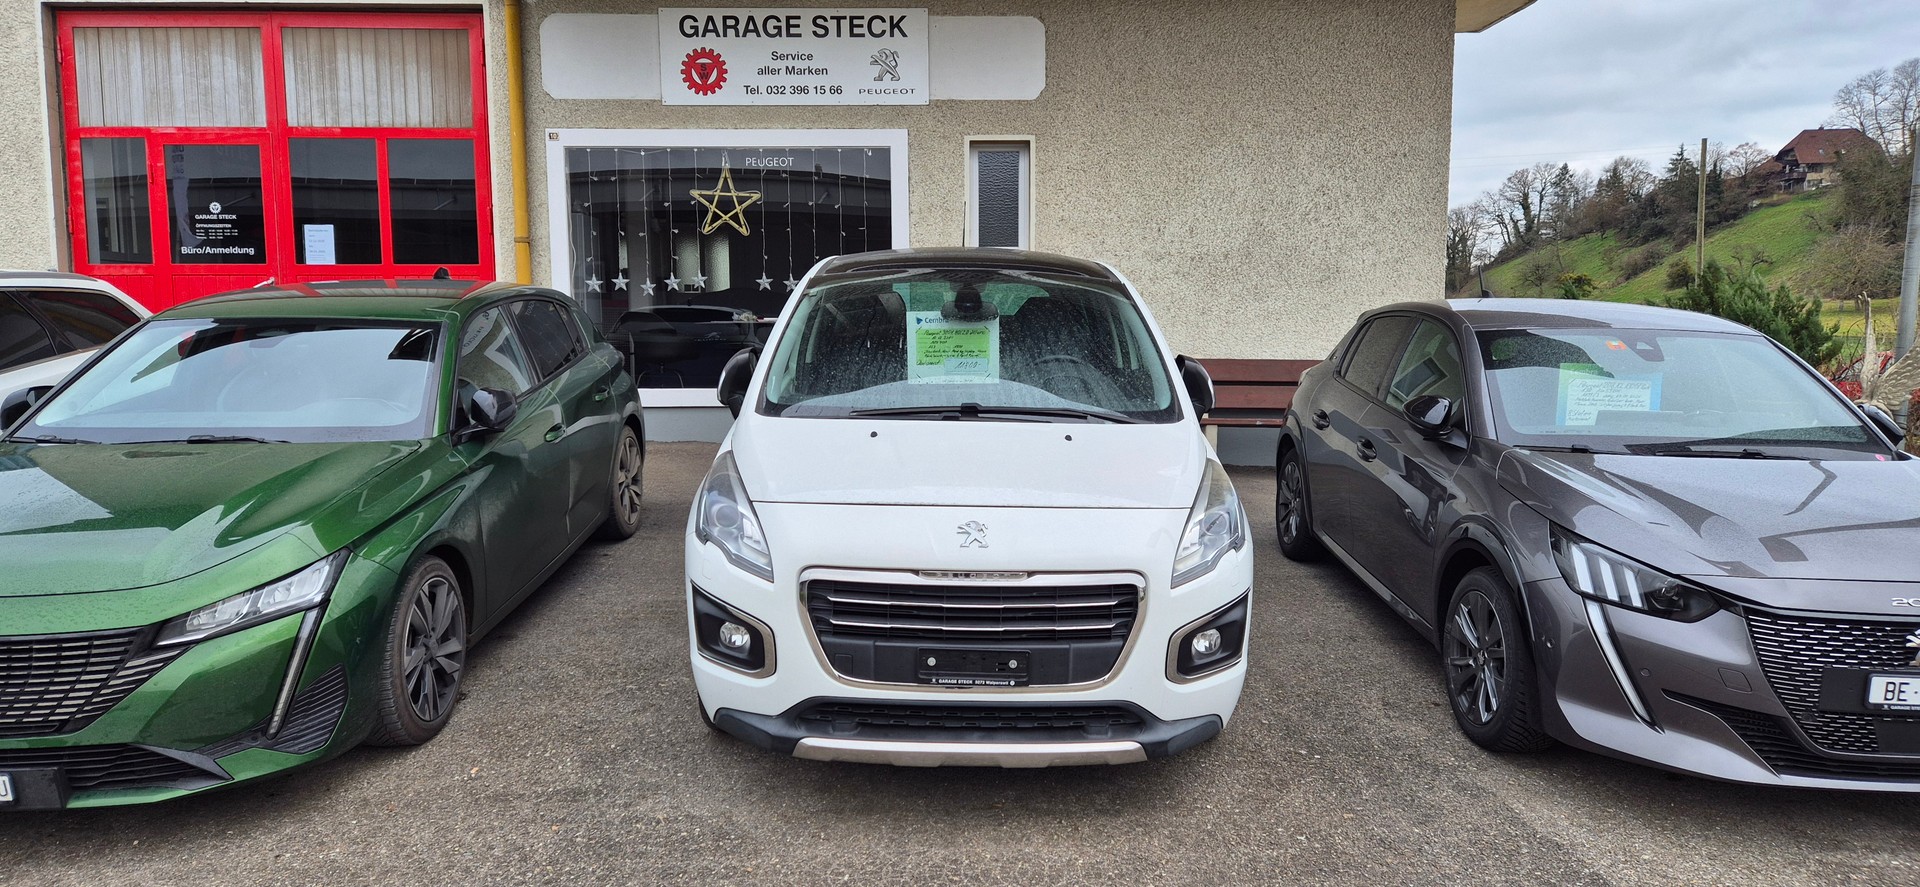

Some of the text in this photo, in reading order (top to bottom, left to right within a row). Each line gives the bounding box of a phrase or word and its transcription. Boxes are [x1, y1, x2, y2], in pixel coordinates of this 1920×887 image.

[678, 15, 908, 38] GARAGE STECK
[771, 51, 814, 61] Service
[757, 65, 828, 76] aller Marken
[743, 85, 843, 95] Tel. 032 396 15 66
[745, 157, 795, 167] PEUGEOT
[181, 246, 255, 255] Büro/Anmeldung
